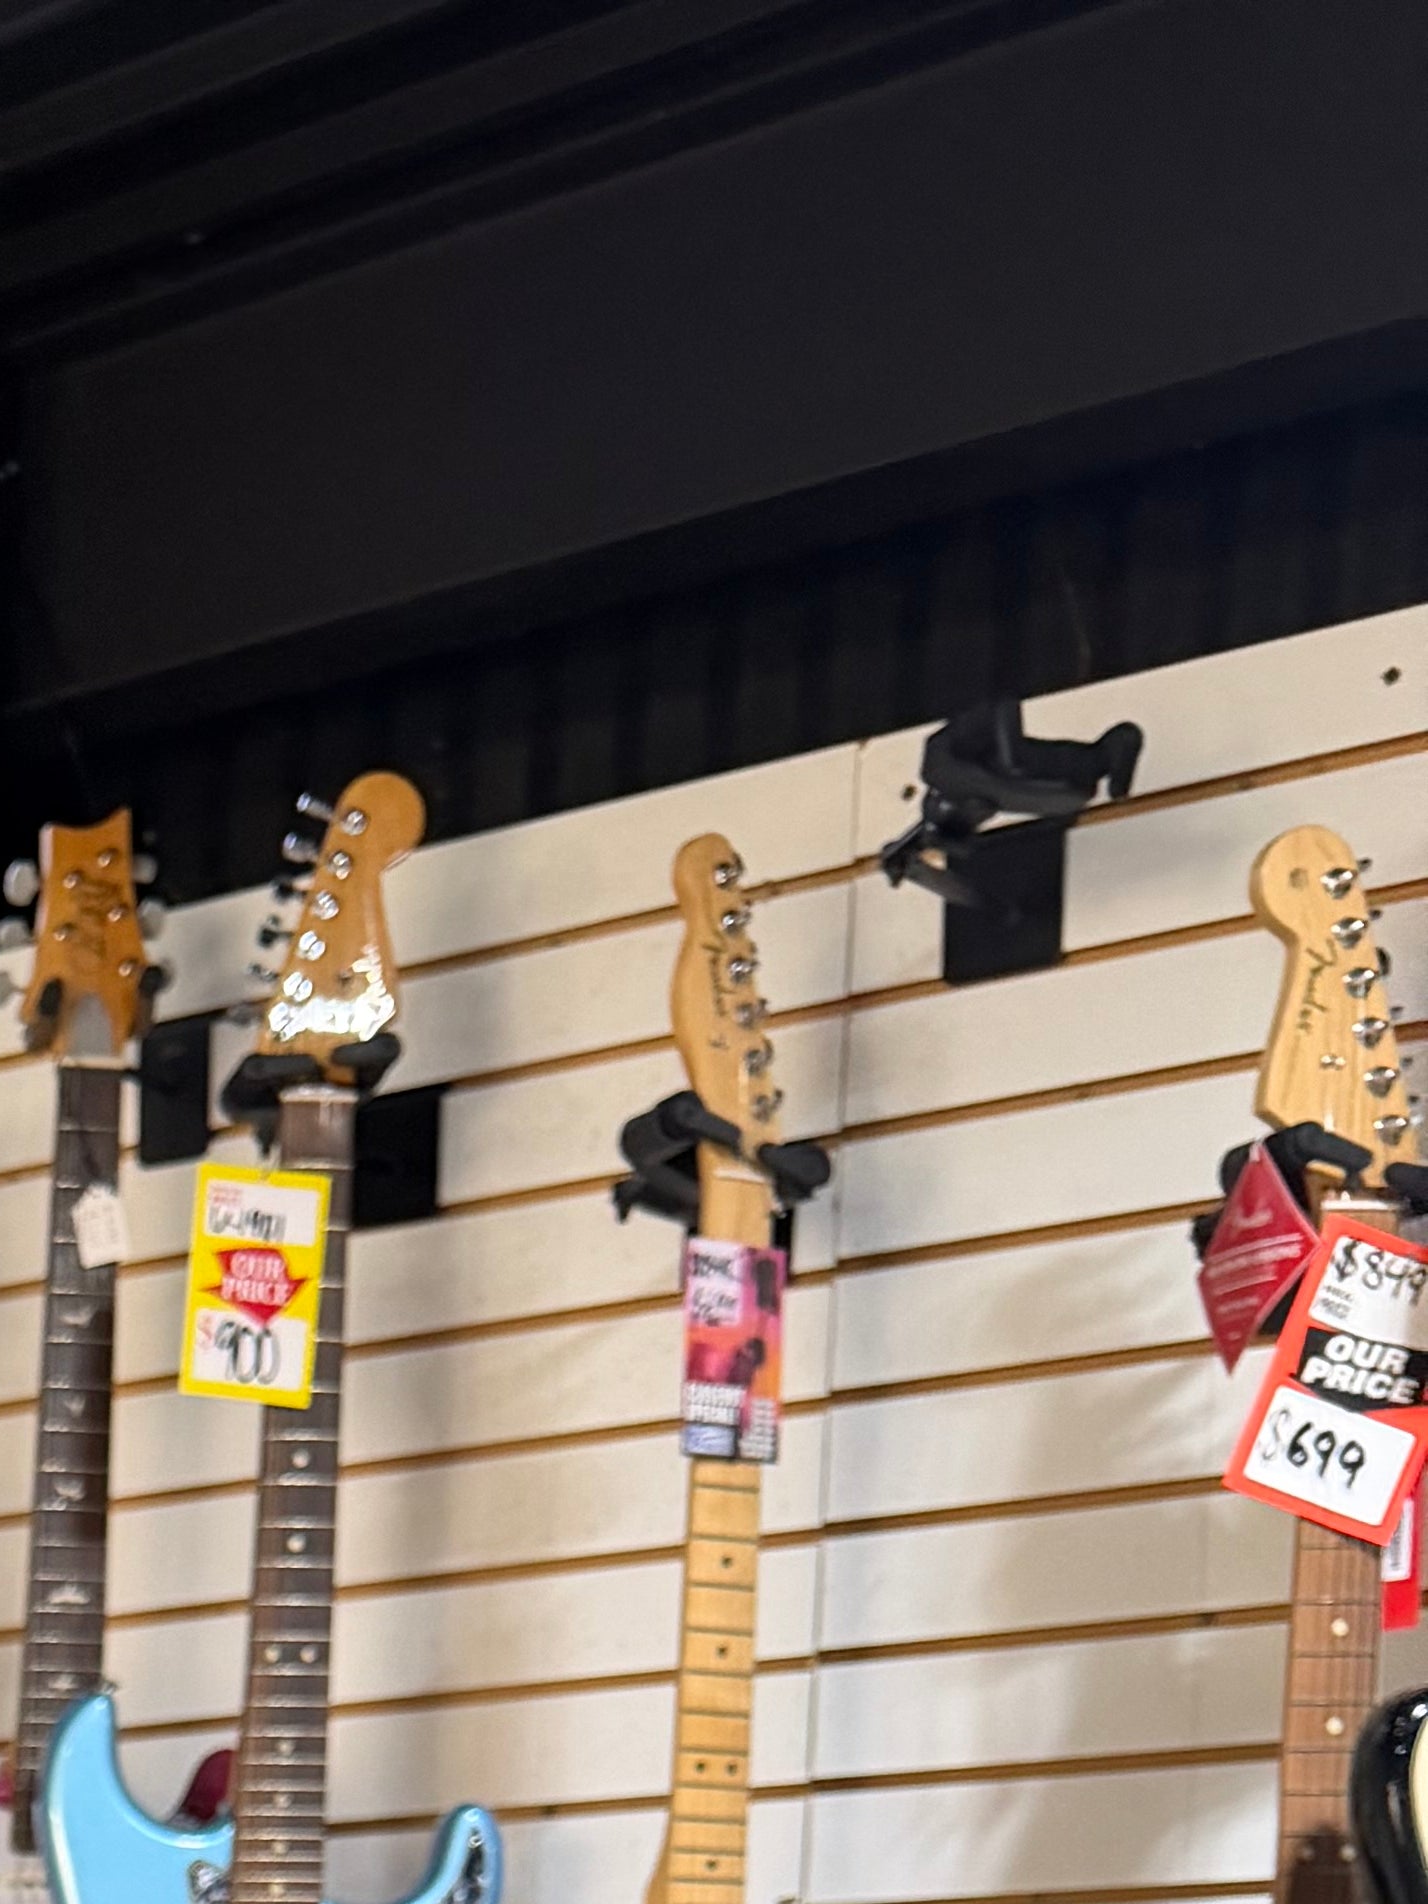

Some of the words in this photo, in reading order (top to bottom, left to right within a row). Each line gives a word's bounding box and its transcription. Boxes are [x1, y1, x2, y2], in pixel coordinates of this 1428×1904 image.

[1324, 1334, 1411, 1375] OUR
[1300, 1357, 1421, 1405] PRICE
[1259, 1405, 1366, 1489] $699
